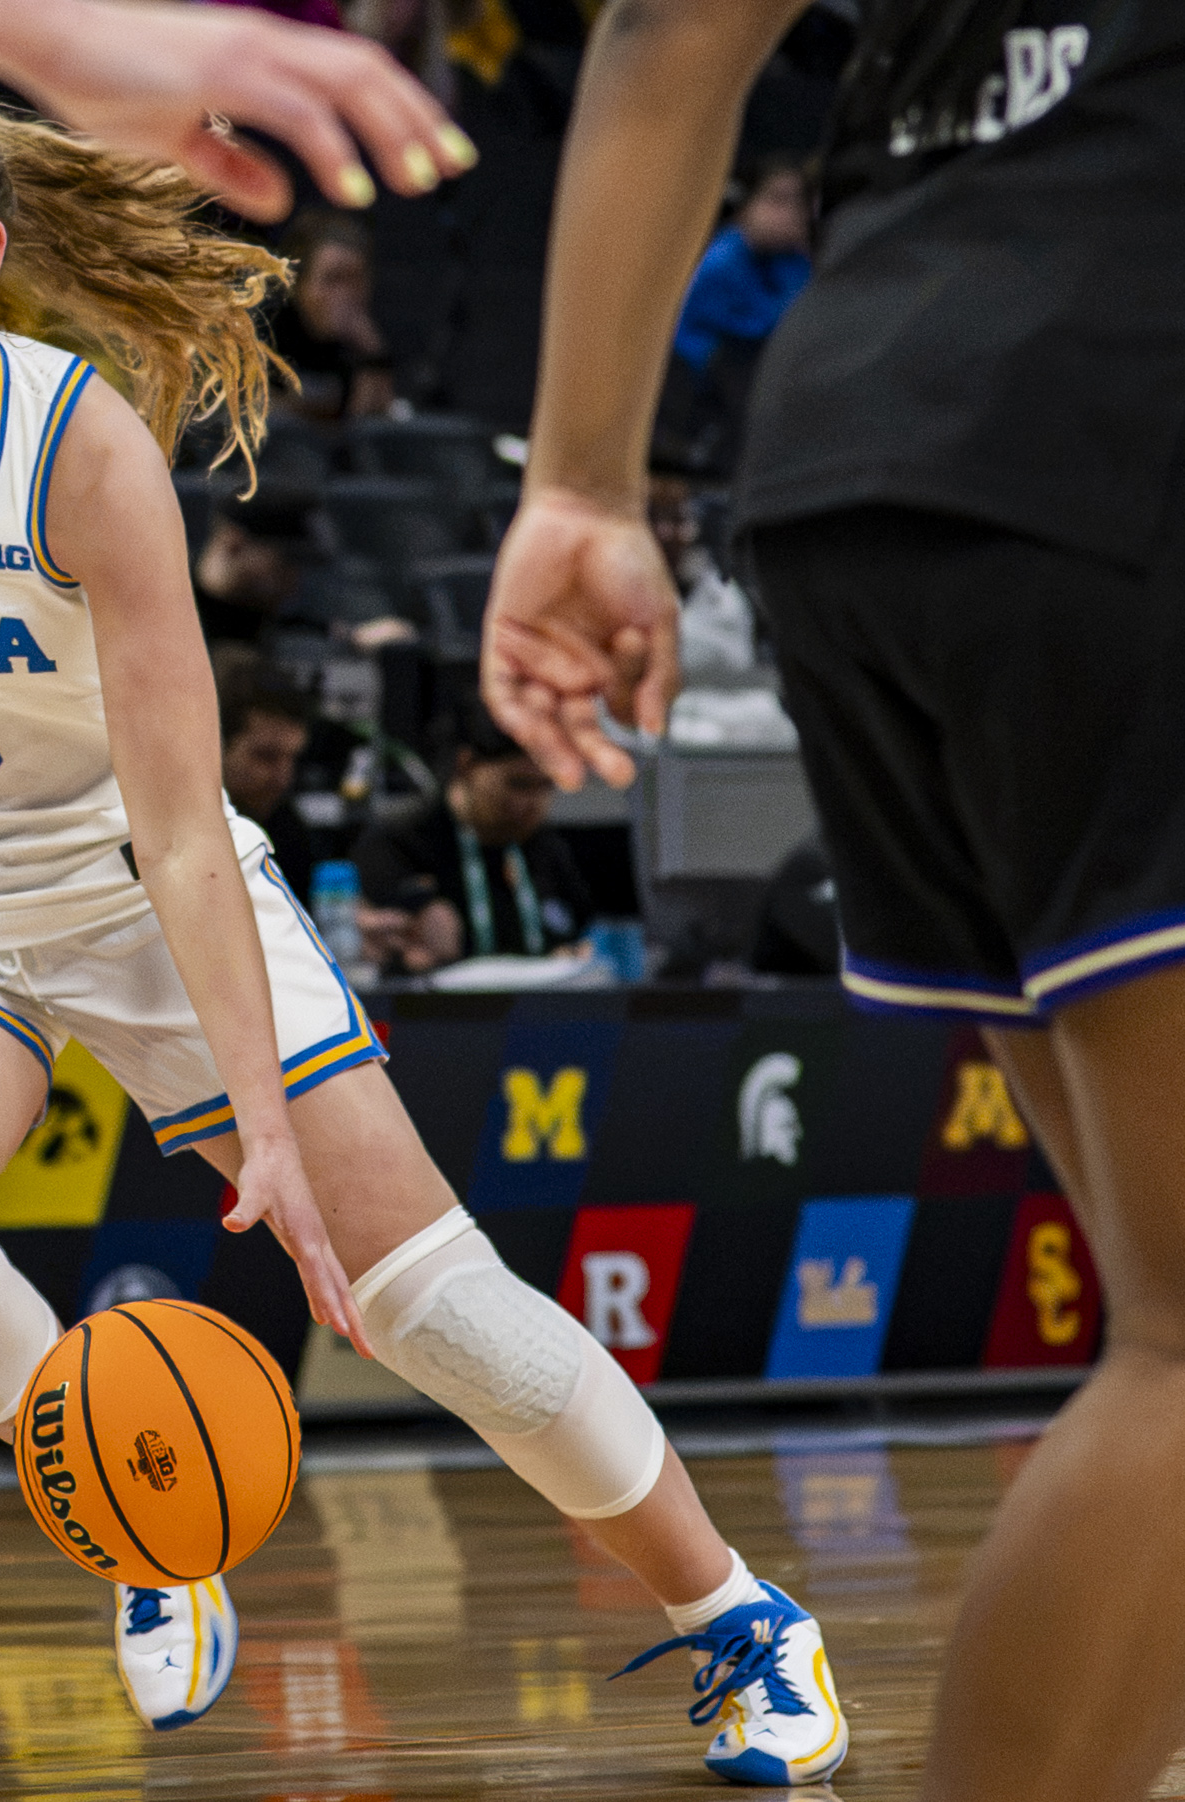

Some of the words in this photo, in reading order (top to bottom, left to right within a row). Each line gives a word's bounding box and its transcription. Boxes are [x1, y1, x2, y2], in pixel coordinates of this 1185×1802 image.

[502, 1067, 587, 1162] M
[581, 1250, 658, 1350] R
[31, 1381, 119, 1570] Wilson
